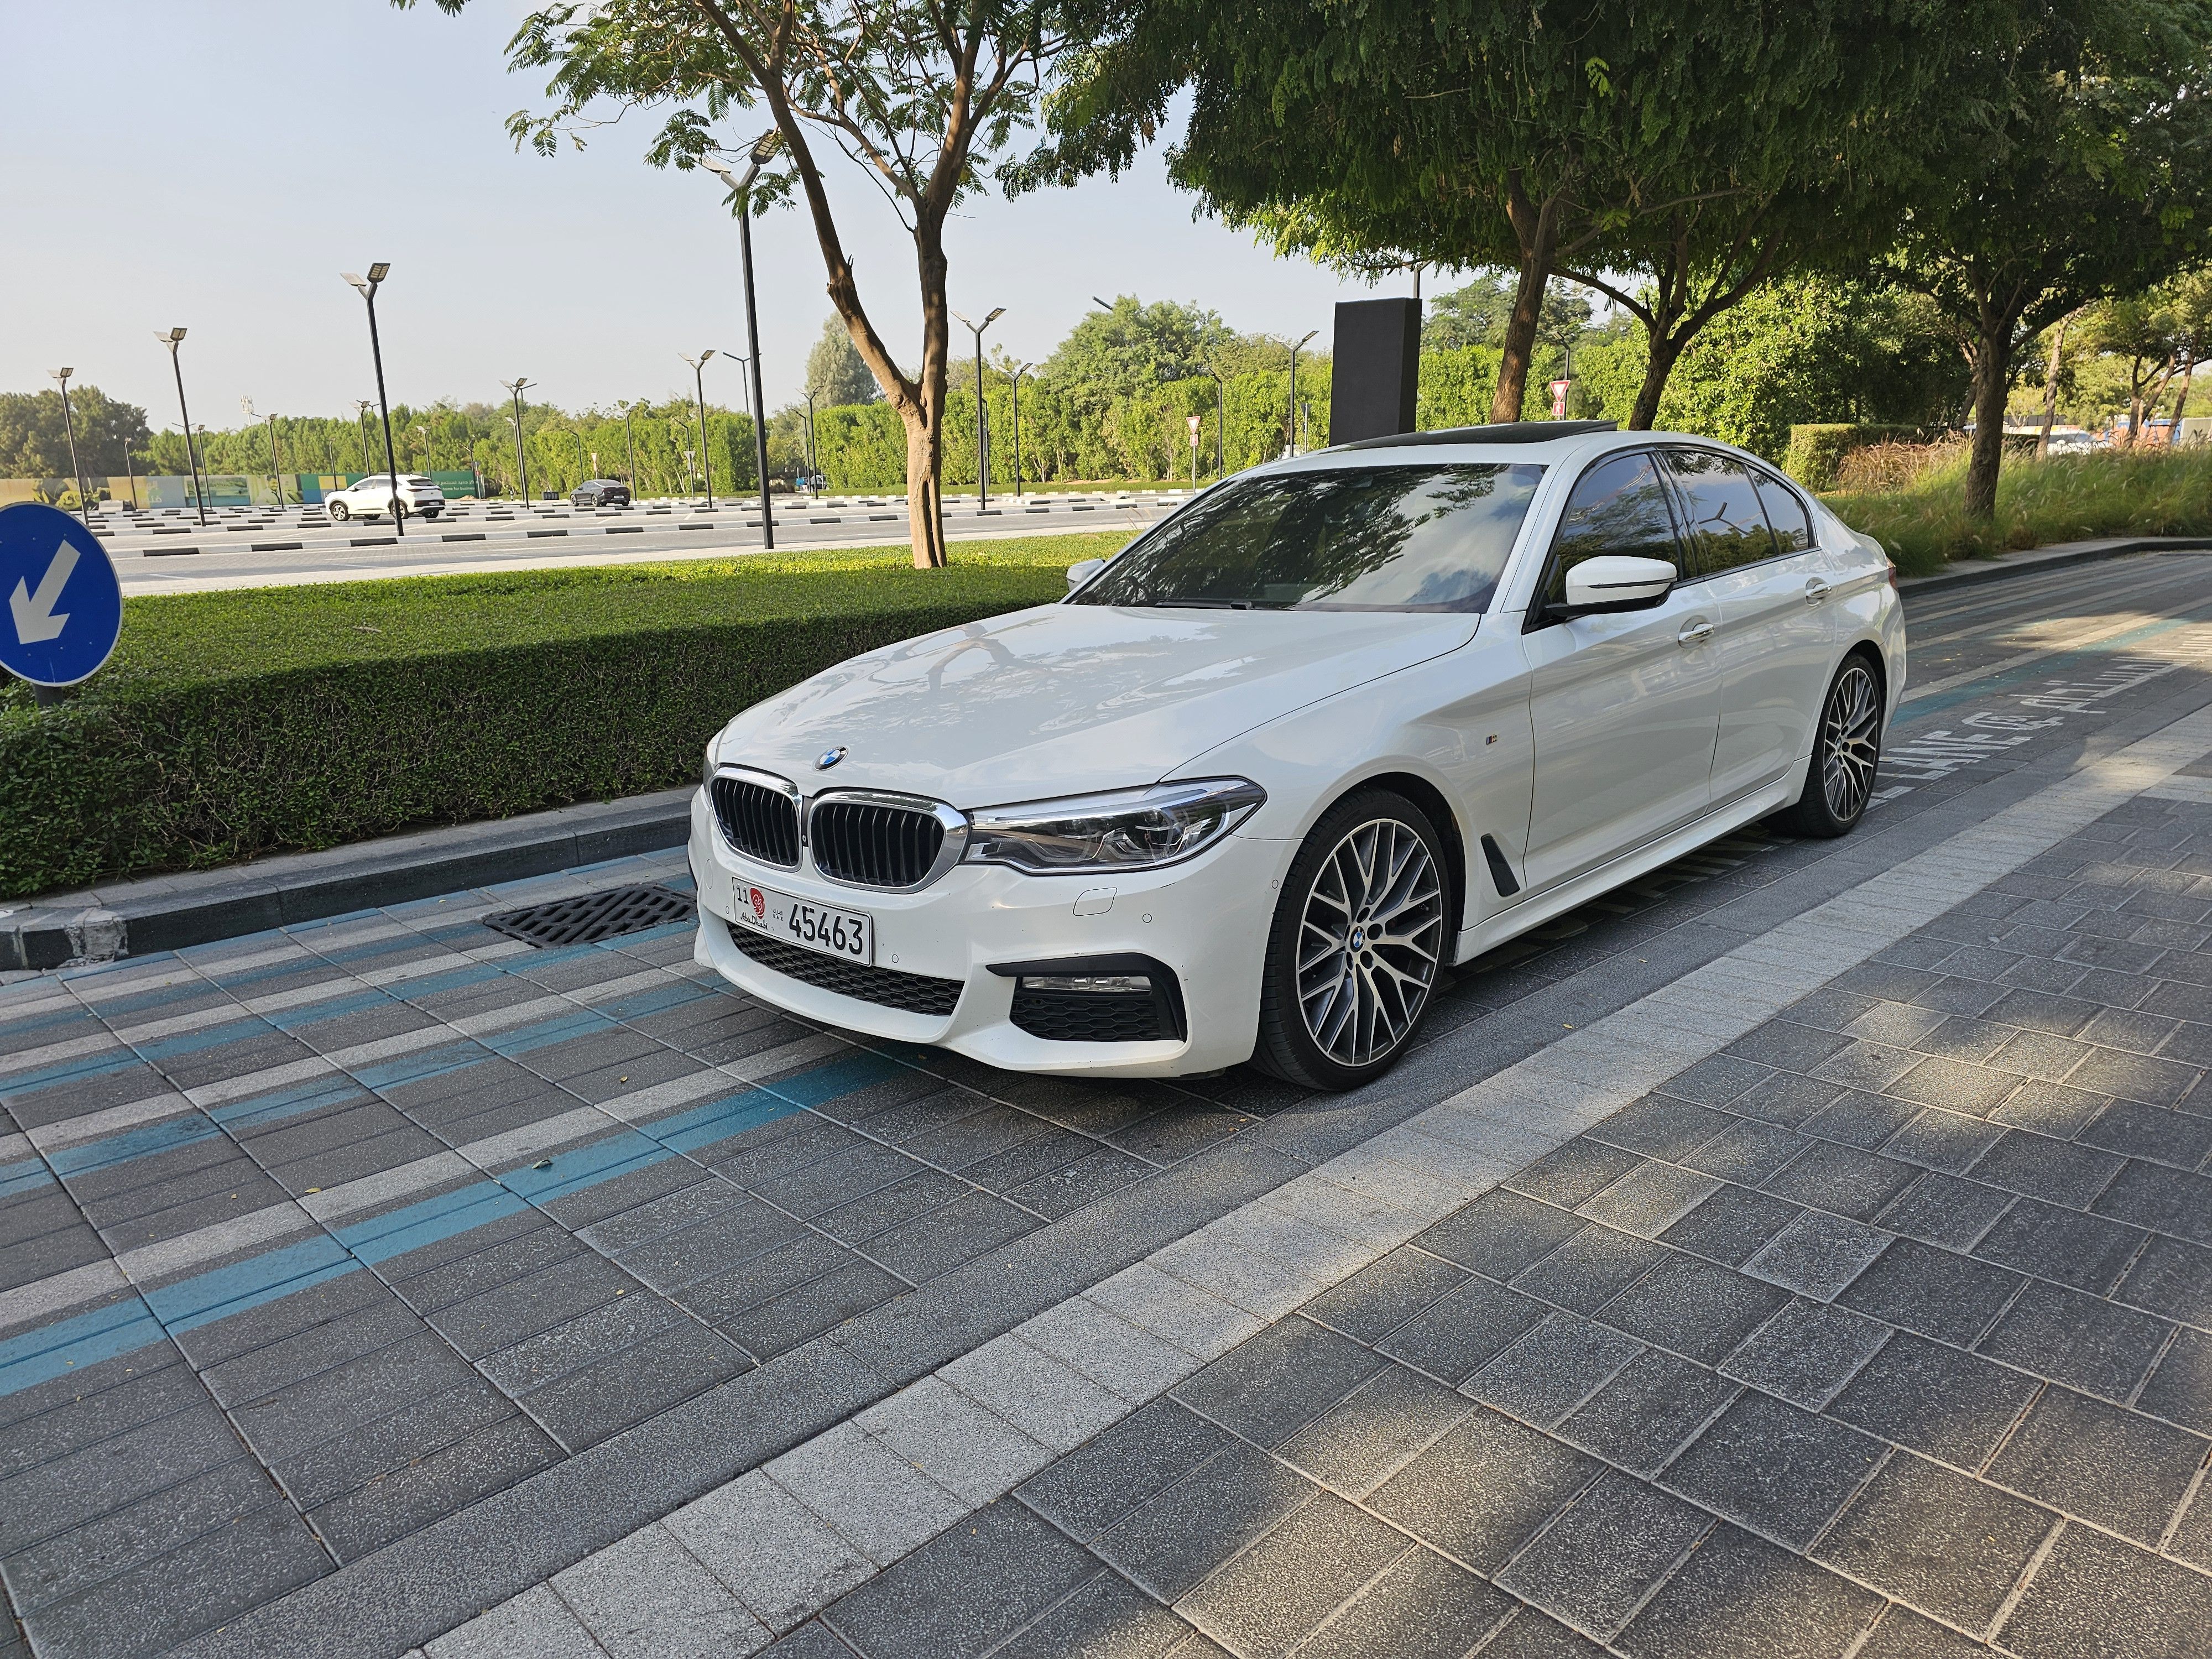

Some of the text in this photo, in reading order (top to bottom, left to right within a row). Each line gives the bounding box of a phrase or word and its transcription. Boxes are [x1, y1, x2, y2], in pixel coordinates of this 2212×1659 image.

[1876, 730, 2033, 780] LANE
[735, 884, 863, 955] 11 45463
